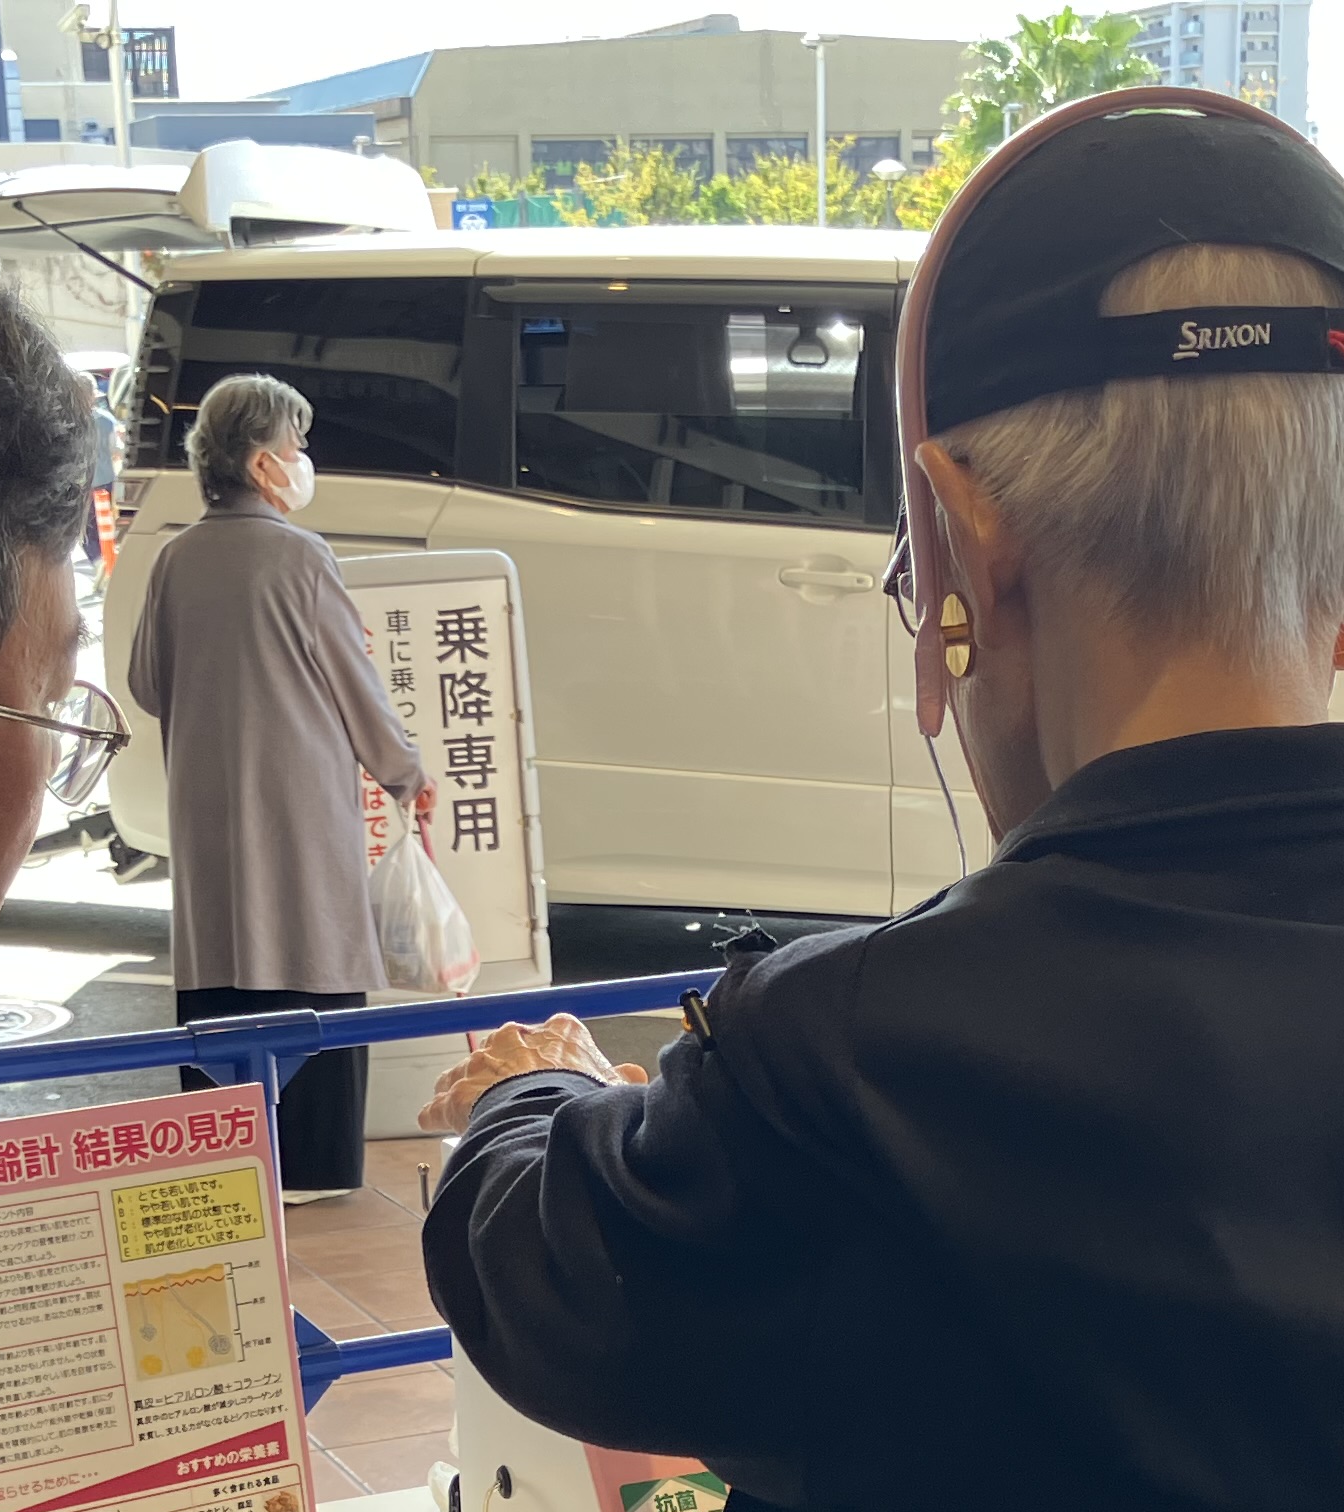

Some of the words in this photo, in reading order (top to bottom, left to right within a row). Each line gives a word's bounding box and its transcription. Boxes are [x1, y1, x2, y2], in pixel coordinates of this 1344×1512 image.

[1176, 321, 1271, 352] SRIXON
[385, 609, 419, 738] 車に乗っ
[433, 605, 501, 853] 乗降専用
[73, 1107, 257, 1171] 結果の見方
[137, 1177, 223, 1202] とても若い肌です。
[138, 1192, 215, 1215] やや若い肌です。
[140, 1200, 246, 1228] 標準的な肌の状態です。
[142, 1211, 257, 1242] やや肌が老化しています。
[144, 1227, 239, 1255] 肌が老化しています。
[177, 1445, 280, 1476] おすすめの栄養素
[211, 1473, 280, 1498] 多く含まれる食品
